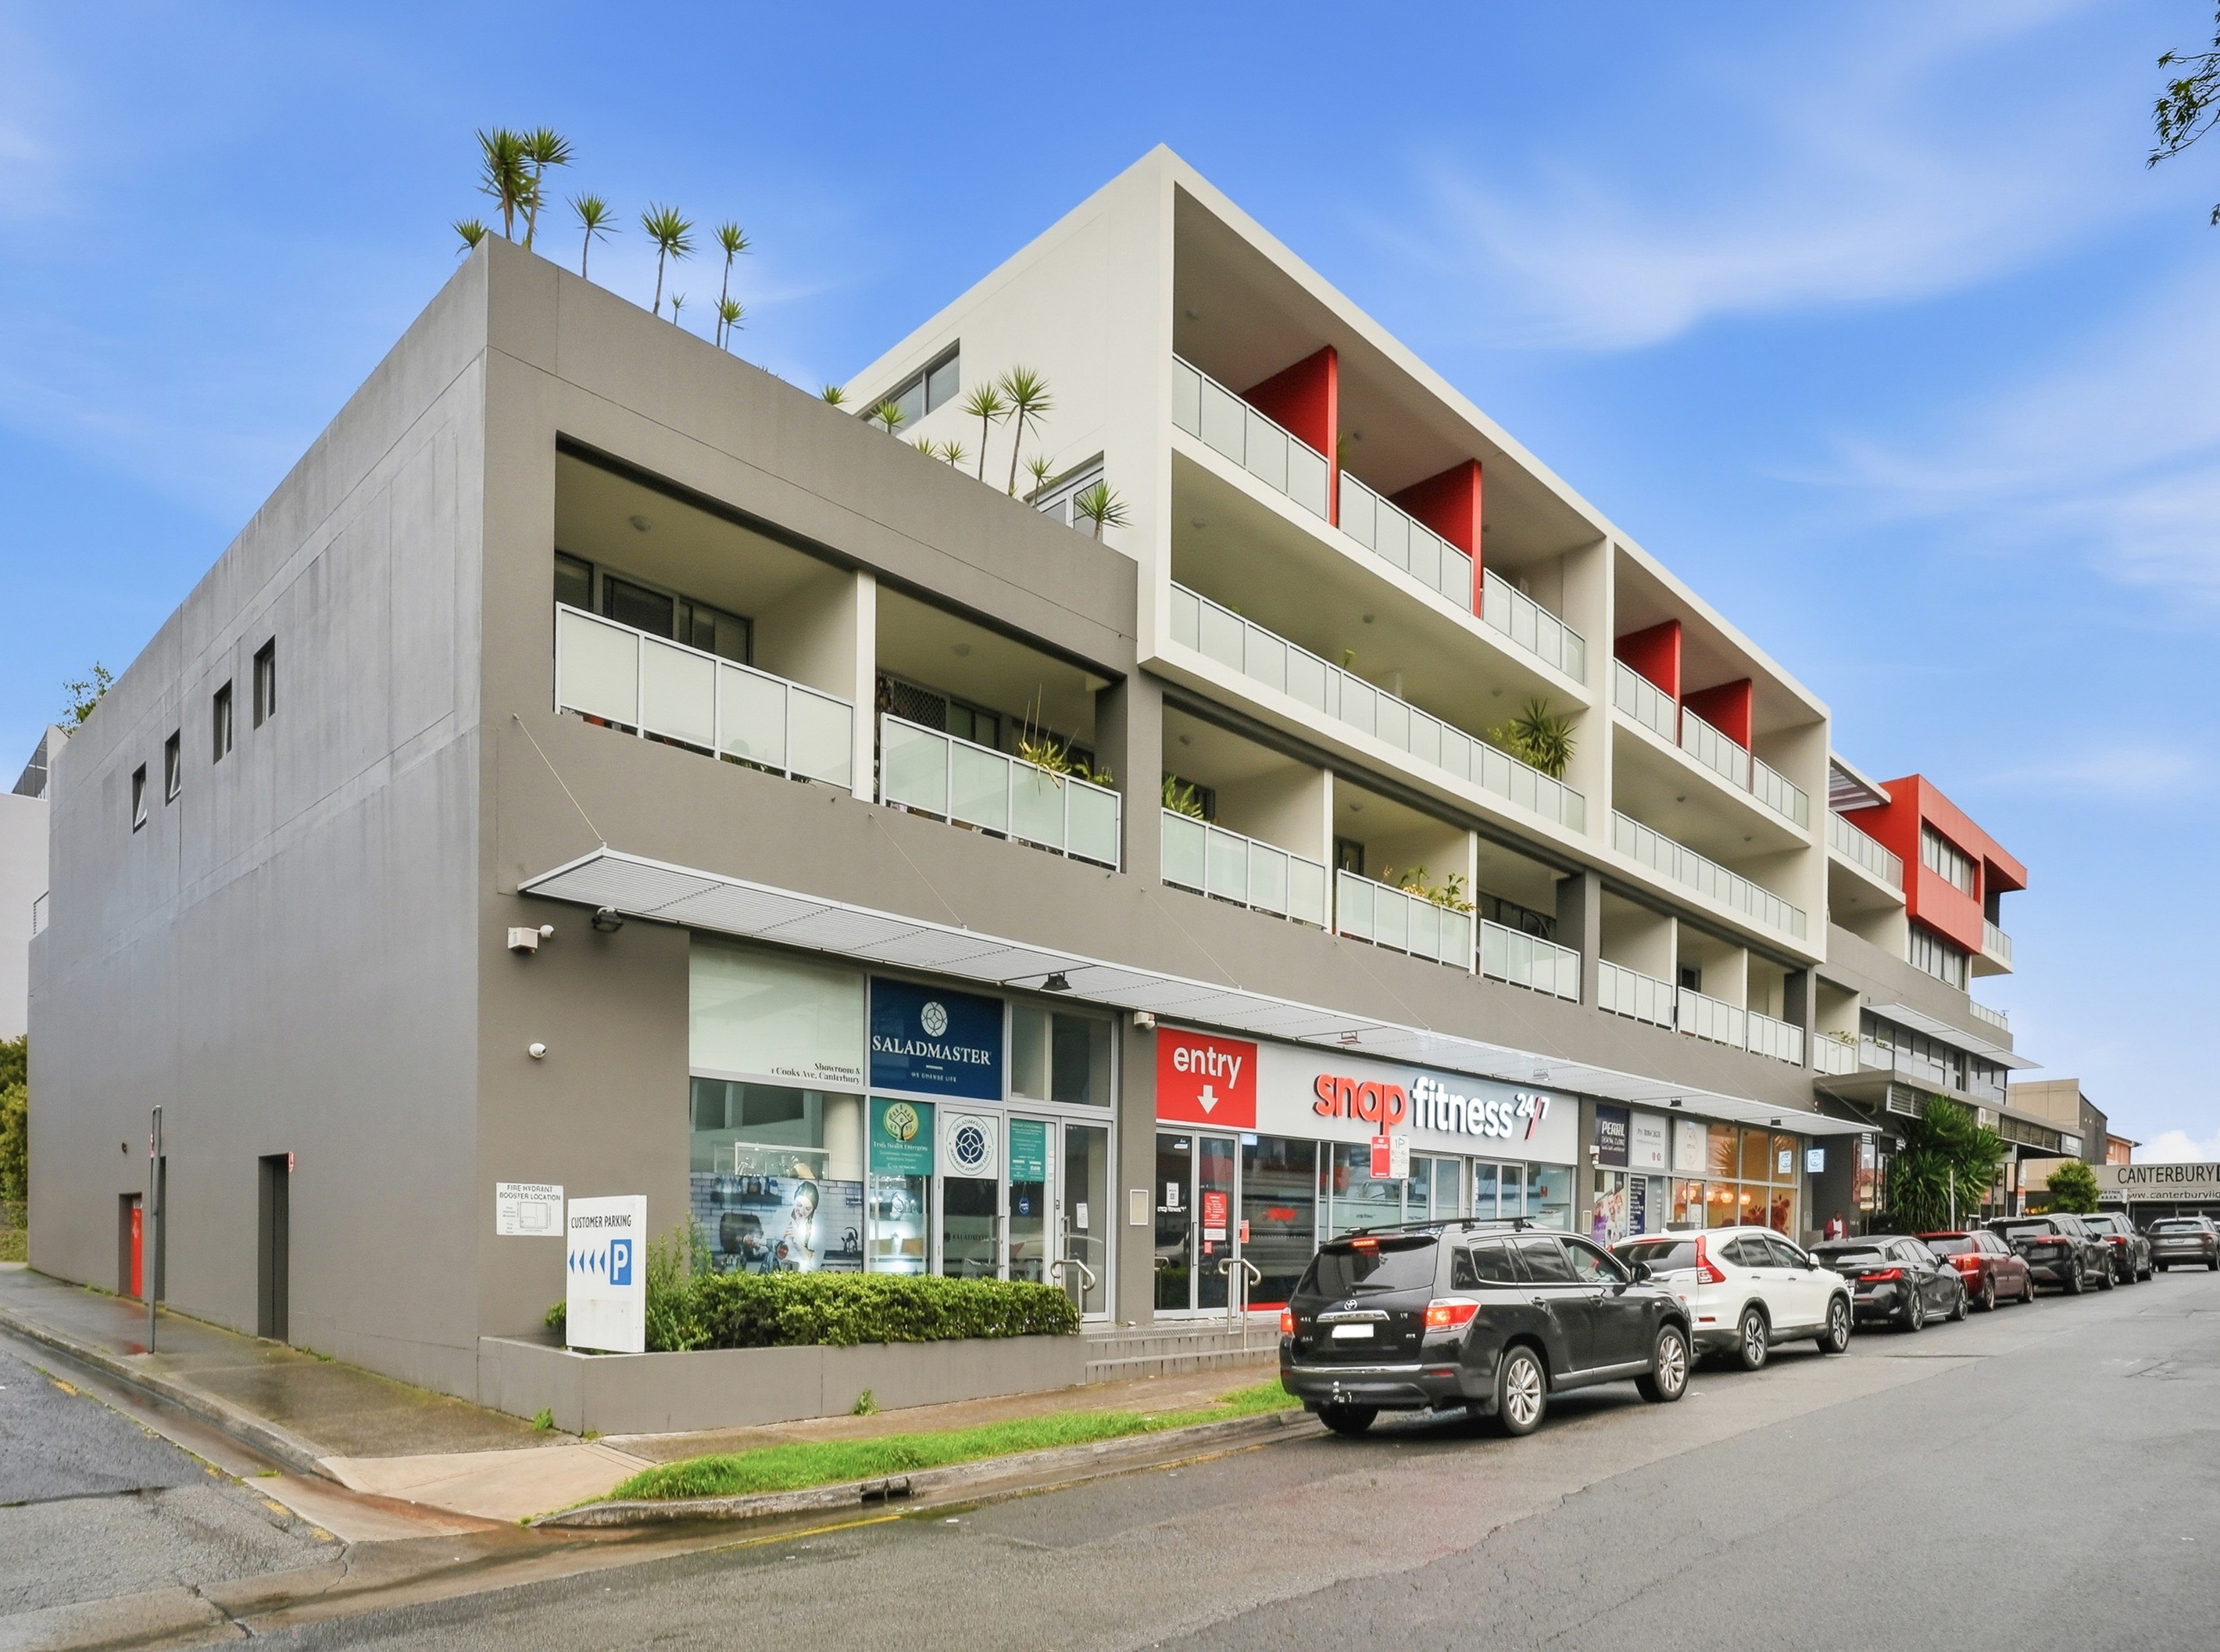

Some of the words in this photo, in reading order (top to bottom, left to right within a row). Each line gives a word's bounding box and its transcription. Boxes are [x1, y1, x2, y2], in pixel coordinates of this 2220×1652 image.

[872, 1035, 991, 1065] SALADMASTER
[776, 1067, 800, 1077] Cooks
[819, 1071, 860, 1085] Canterbury
[1173, 1046, 1242, 1089] entry
[1314, 1073, 1407, 1135] snap
[1410, 1075, 1514, 1139] fitness
[1514, 1092, 1550, 1141] 24/7
[1601, 1121, 1625, 1136] PEARL
[2118, 1165, 2215, 1184] CANTERBURY
[499, 1192, 529, 1200] BOOSTER
[530, 1193, 561, 1201] LOCATION
[570, 1216, 603, 1229] CUSTOMER
[604, 1214, 632, 1228] PARKING
[613, 1243, 629, 1281] P
